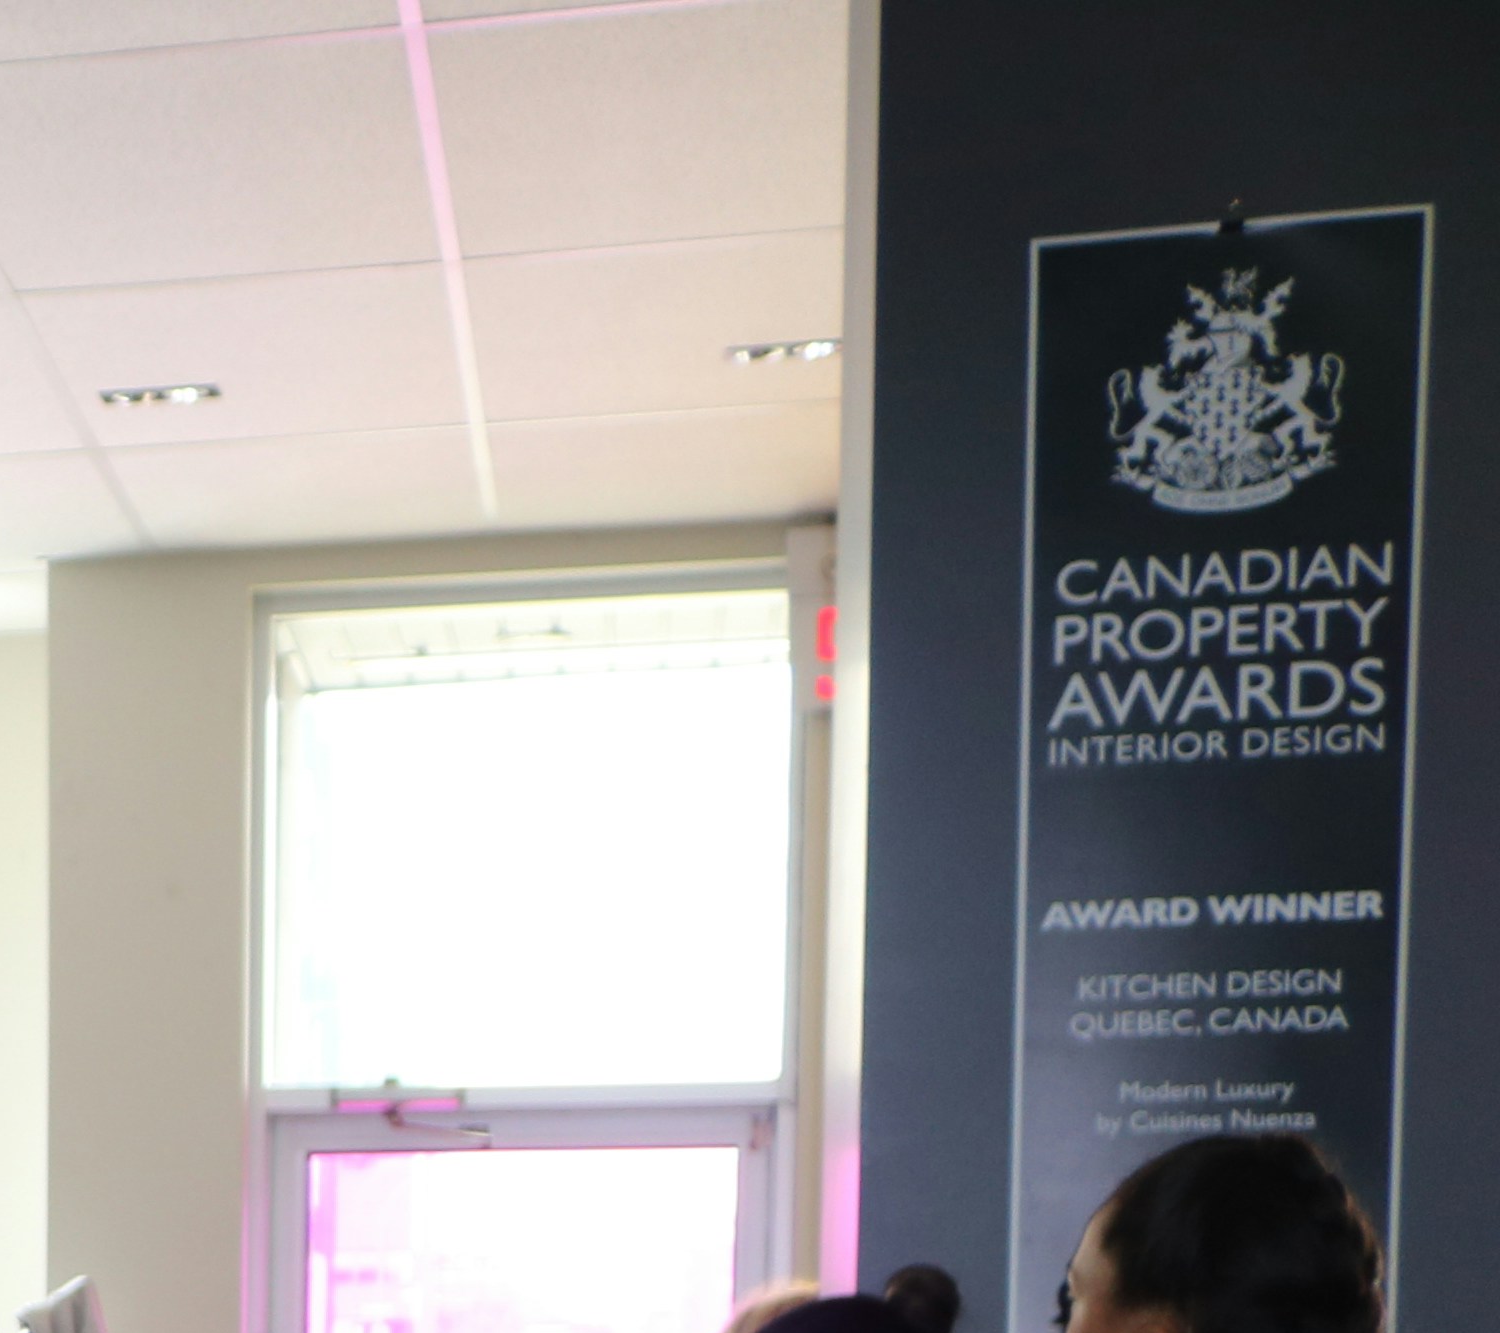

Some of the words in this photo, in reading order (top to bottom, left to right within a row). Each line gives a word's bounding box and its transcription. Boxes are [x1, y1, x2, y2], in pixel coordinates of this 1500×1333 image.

[1056, 540, 1394, 605] CANADIAN
[1052, 597, 1388, 666] PROPERTY
[1047, 656, 1386, 732] AWARDS
[1048, 730, 1228, 768] INTERIOR
[1241, 722, 1387, 759] DESIGN
[1040, 896, 1199, 932] AWARD
[1208, 890, 1384, 925] WINNER
[1077, 971, 1218, 1002] KITCHEN
[1225, 968, 1344, 999] DESIGN
[1069, 1008, 1203, 1043] QUEBEC,
[1208, 1004, 1349, 1036] CANADA
[1119, 1079, 1207, 1102] Modern
[1215, 1077, 1295, 1104] Luxury
[1096, 1111, 1122, 1137] by
[1130, 1109, 1222, 1131] Cuisines
[1231, 1107, 1317, 1131] Nuenza
